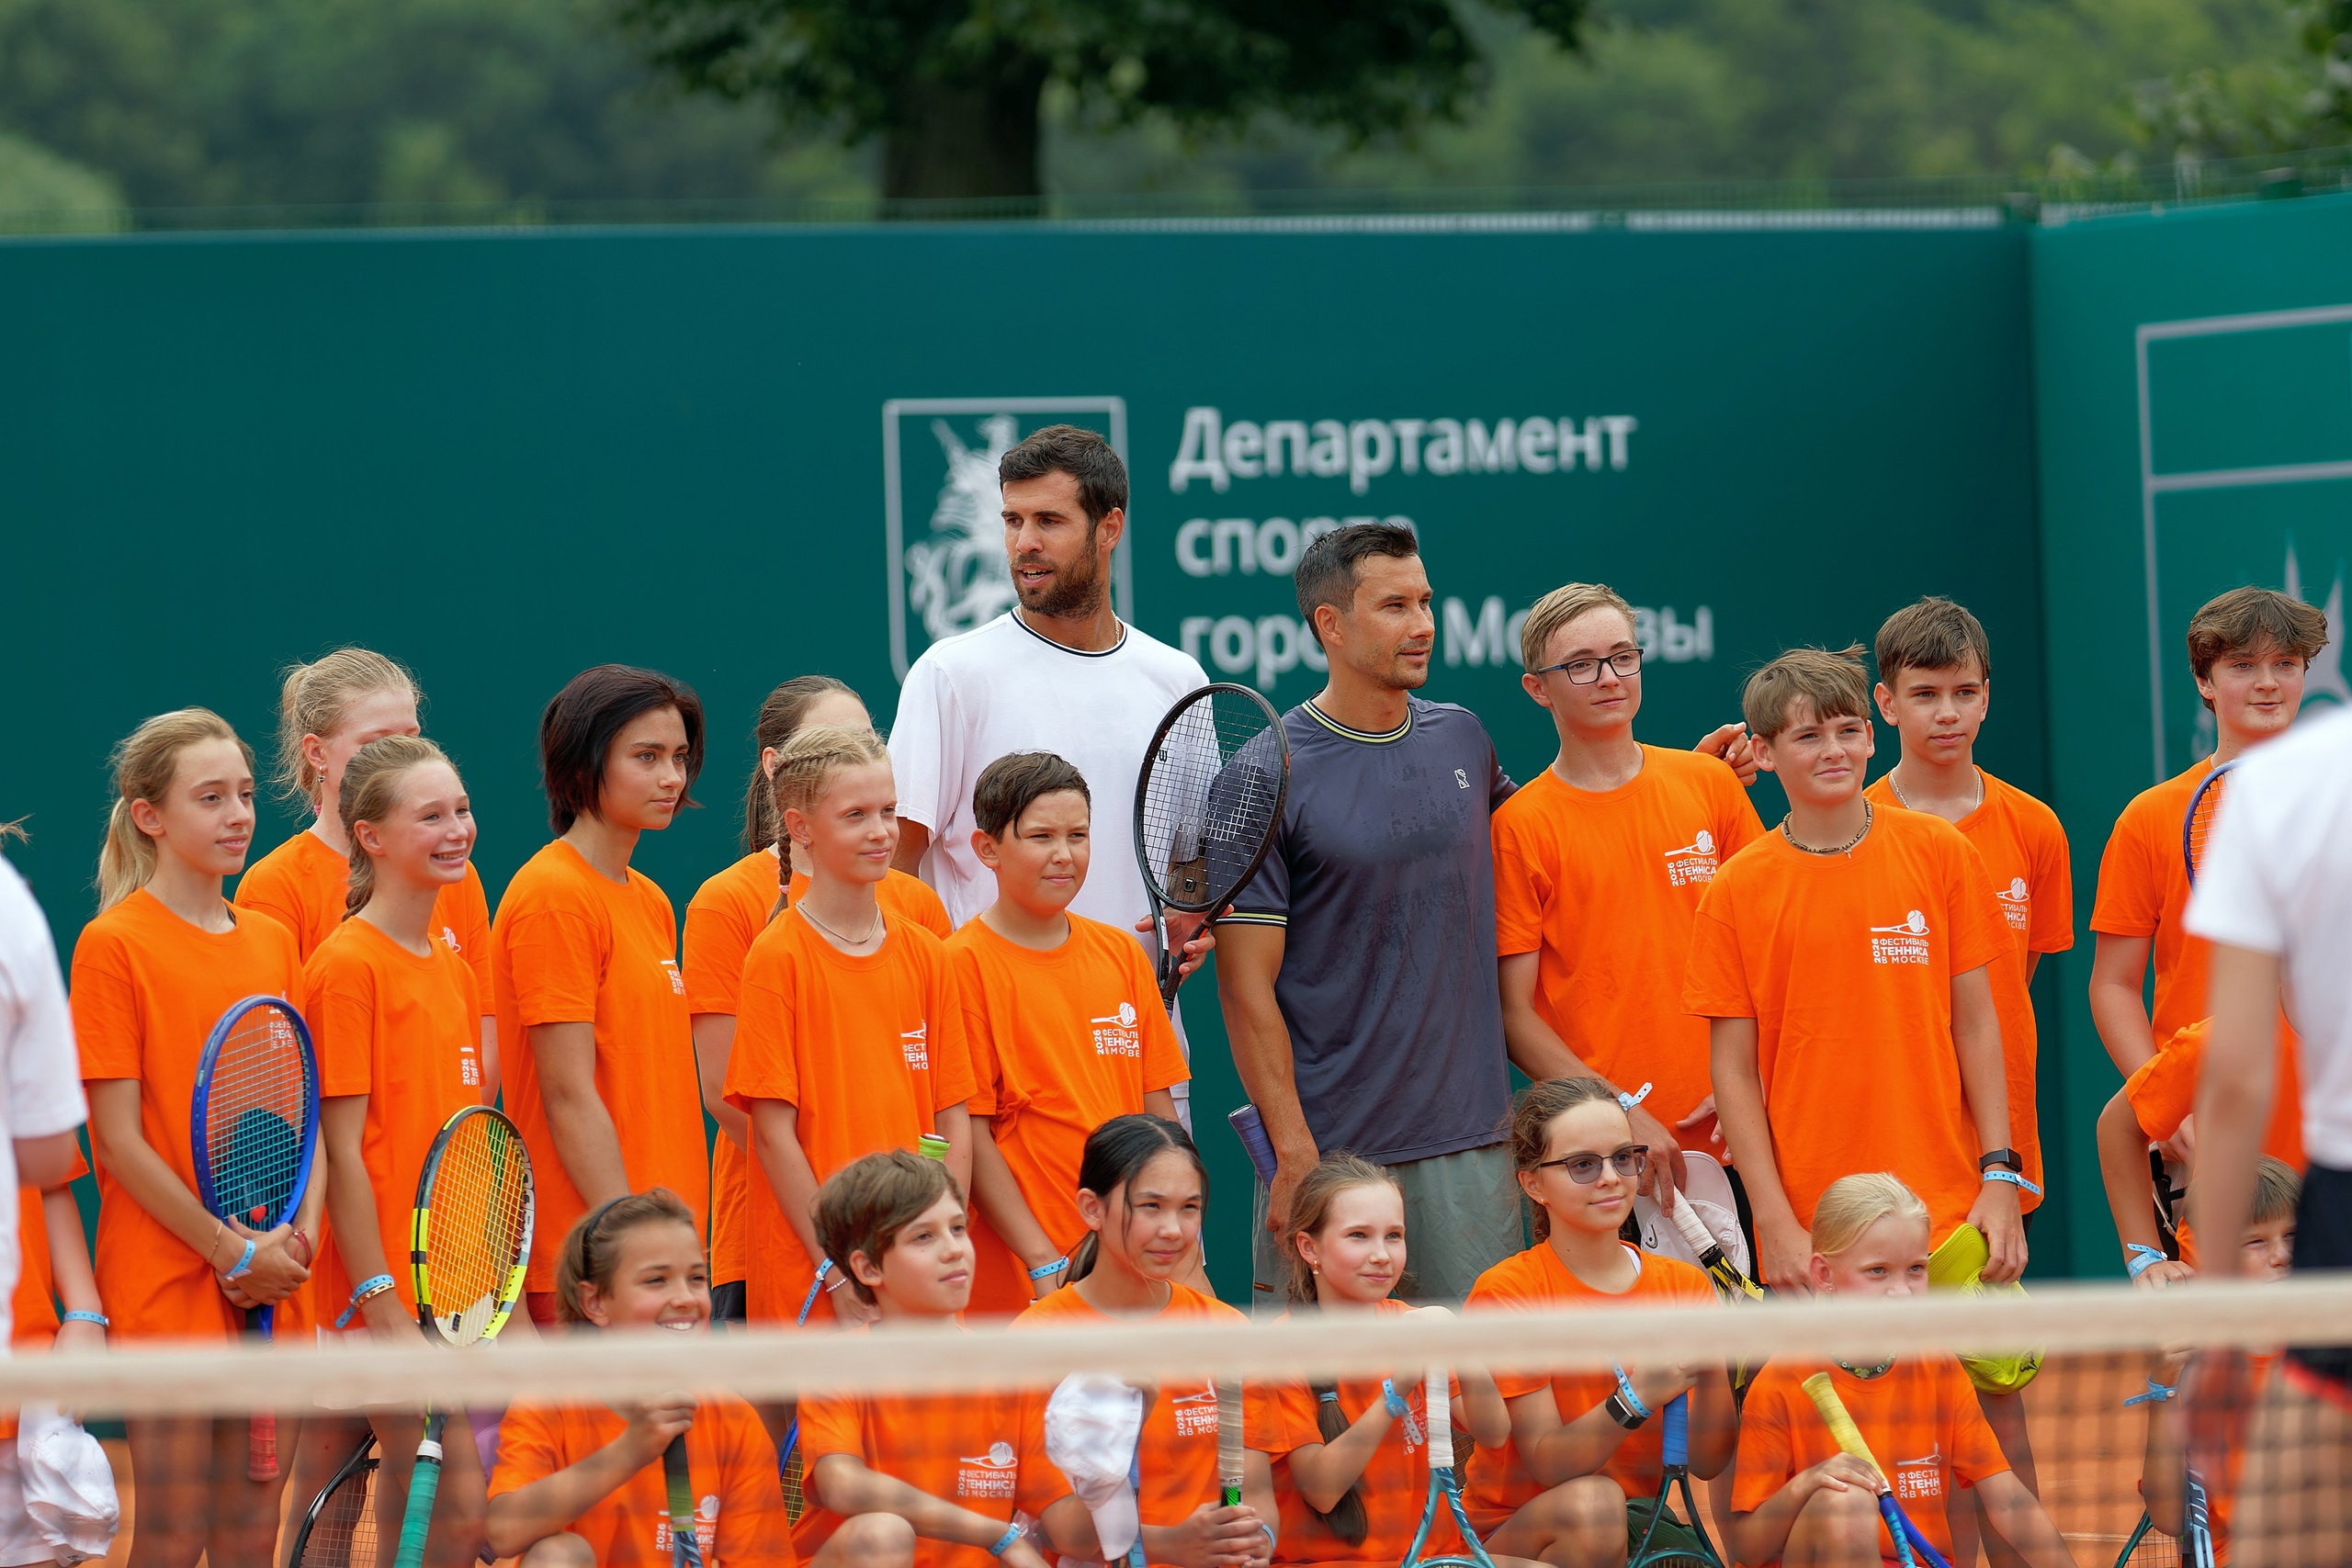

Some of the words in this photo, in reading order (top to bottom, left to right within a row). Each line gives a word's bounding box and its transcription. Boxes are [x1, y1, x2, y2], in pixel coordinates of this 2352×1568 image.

[1170, 407, 1637, 496] Департамент
[1175, 516, 1418, 577] спо
[1871, 938, 1882, 964] 2026
[1880, 938, 1928, 947] ФЕСТИВАЛЬ
[1880, 946, 1928, 956] ТЕННИСА
[1093, 1029, 1104, 1055] 2026
[1111, 1047, 1139, 1057] МОВЕ
[461, 1058, 470, 1085] 2026
[1187, 1427, 1193, 1436] В
[957, 1469, 966, 1496] 2026
[1897, 1472, 1908, 1498] 2026
[1909, 1490, 1917, 1498] В
[656, 1523, 666, 1551] 2026
